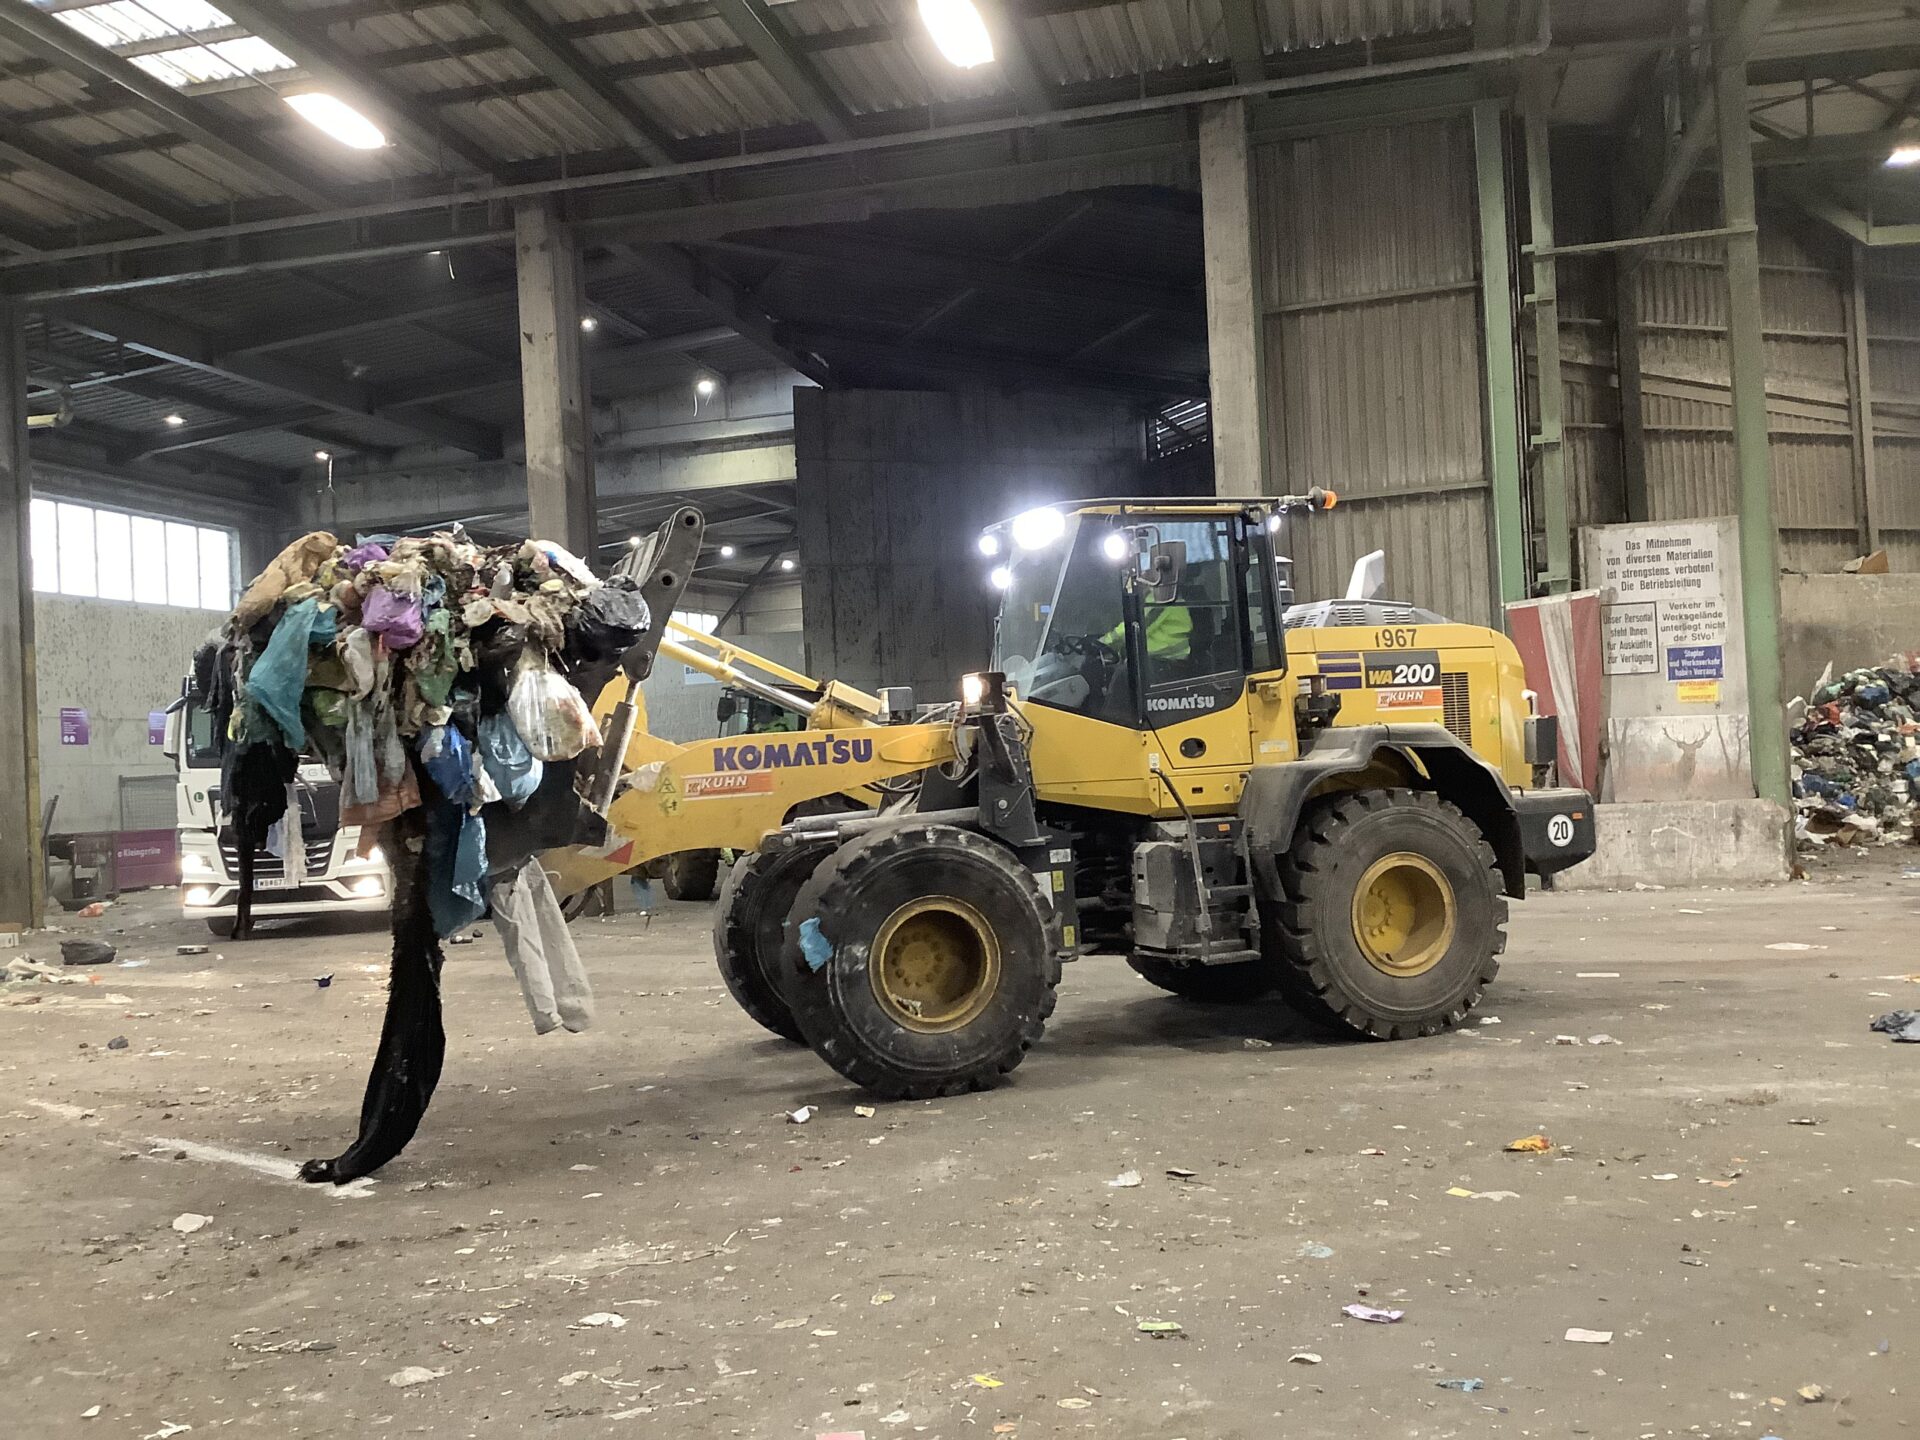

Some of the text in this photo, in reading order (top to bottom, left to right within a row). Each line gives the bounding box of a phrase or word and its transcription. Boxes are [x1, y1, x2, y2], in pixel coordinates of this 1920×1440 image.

[1625, 538, 1692, 550] Das Mitnehmen
[1606, 549, 1713, 566] von diversen Materialien
[1606, 562, 1714, 579] ist strengstens verboten!
[1621, 578, 1701, 591] Die Betriebsleitung
[1669, 600, 1716, 610] Verkehr im
[1662, 611, 1723, 621] Werksgelände
[1705, 621, 1726, 630] nicht
[1374, 628, 1418, 648] 1967
[1673, 634, 1687, 642] der
[1147, 693, 1215, 711] KOMATSU
[1390, 691, 1424, 701] KUHN
[713, 734, 873, 771] KOMATSU
[701, 775, 748, 789] KUHN
[1552, 821, 1568, 840] 20
